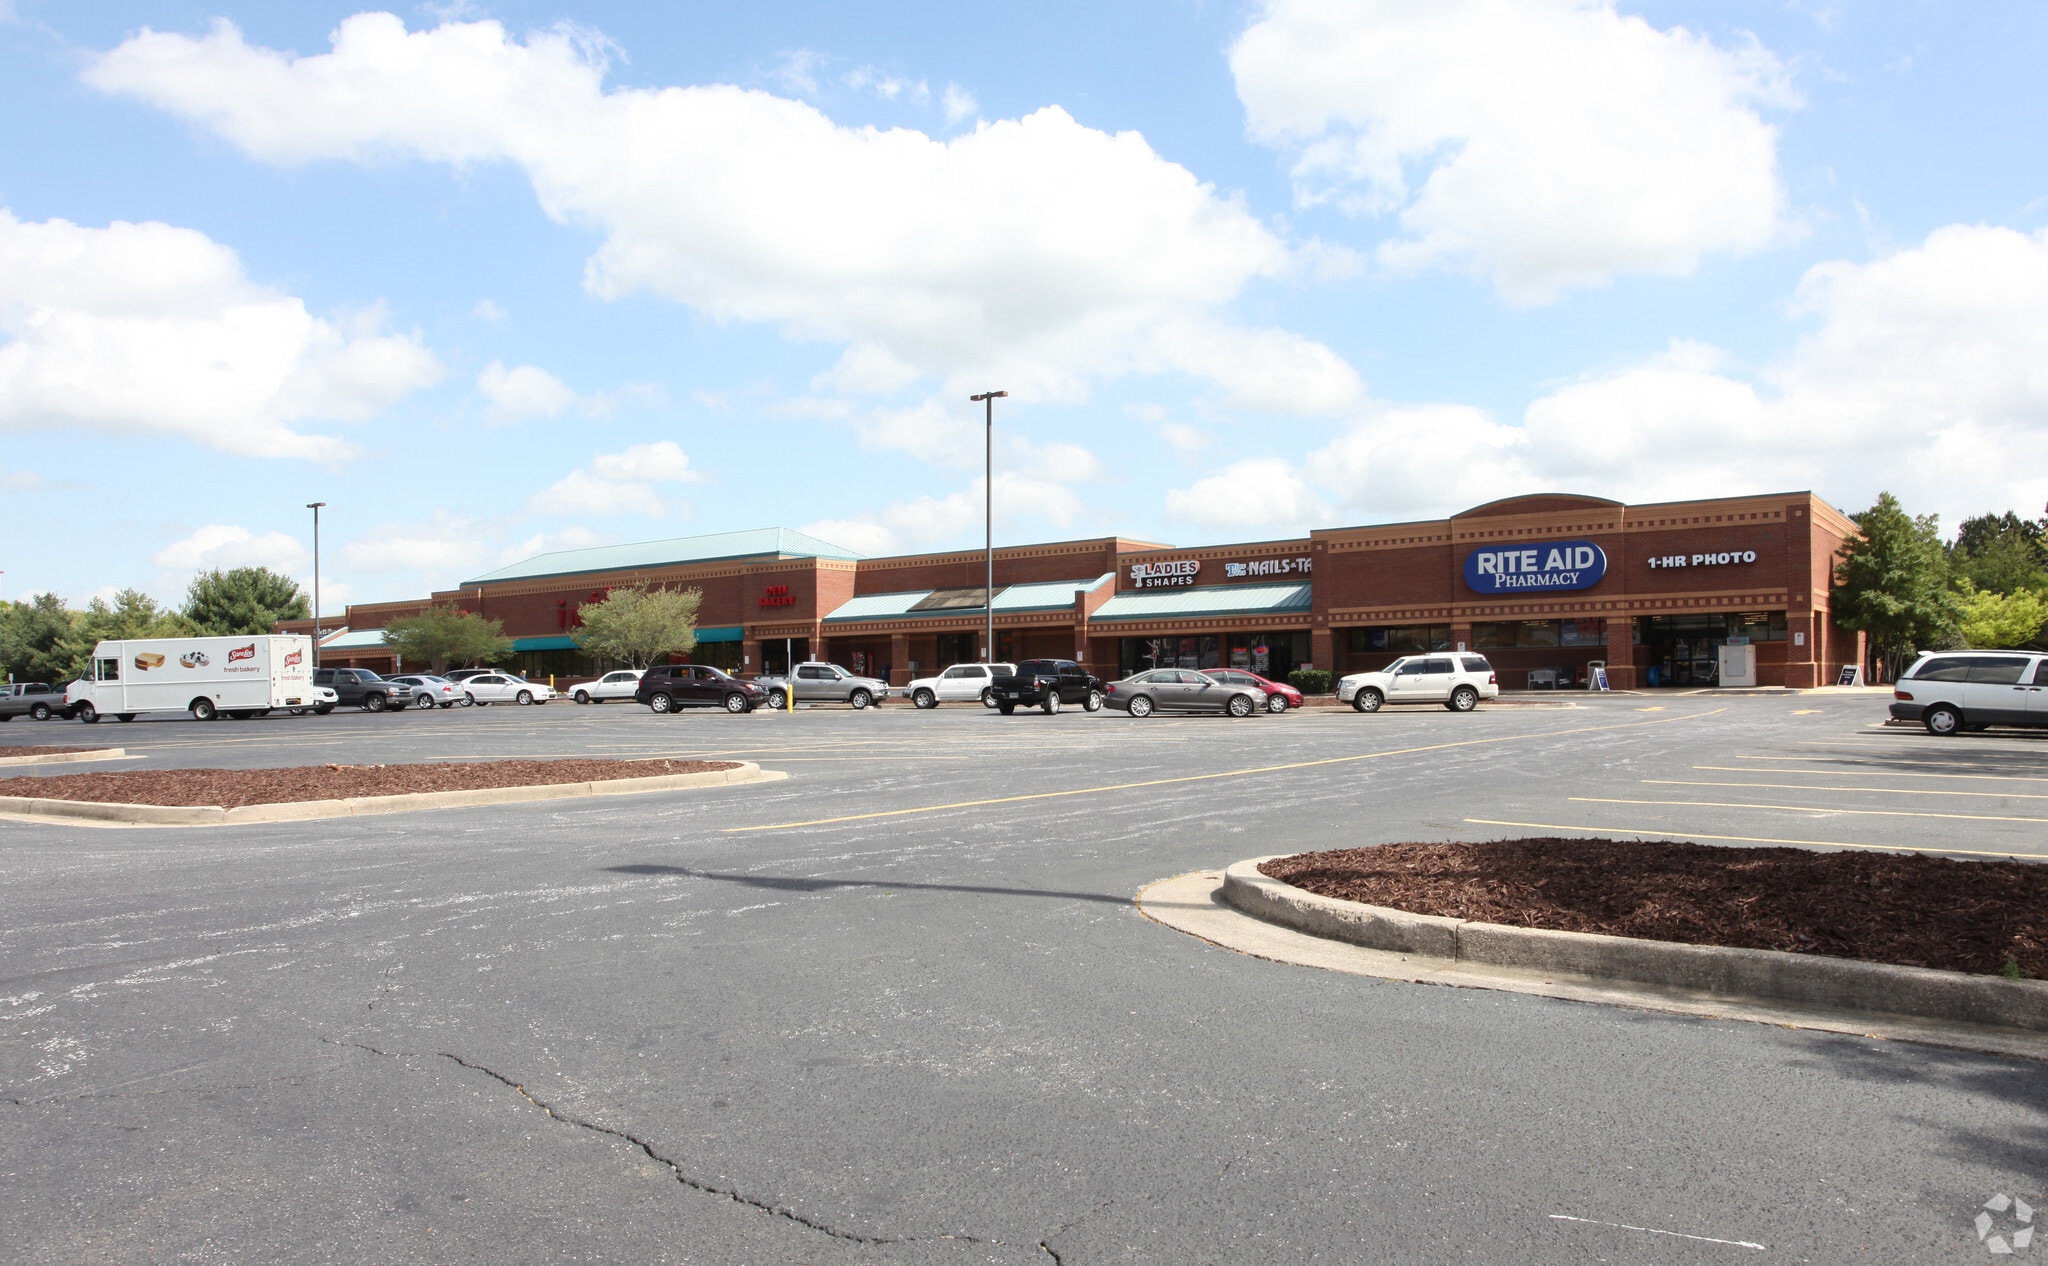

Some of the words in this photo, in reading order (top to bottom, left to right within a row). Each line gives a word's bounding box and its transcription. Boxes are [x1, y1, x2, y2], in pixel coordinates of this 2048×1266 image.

[1248, 558, 1290, 576] NAILS
[1478, 550, 1538, 575] RITE
[1544, 546, 1595, 570] AID
[1647, 555, 1687, 569] 1-HR
[1692, 550, 1757, 566] PHOTO
[1145, 562, 1197, 575] LADIES
[1146, 577, 1193, 587] SHAPES
[1494, 571, 1580, 588] PHARMACY
[766, 585, 788, 595] DELI
[758, 596, 796, 606] BAKERY
